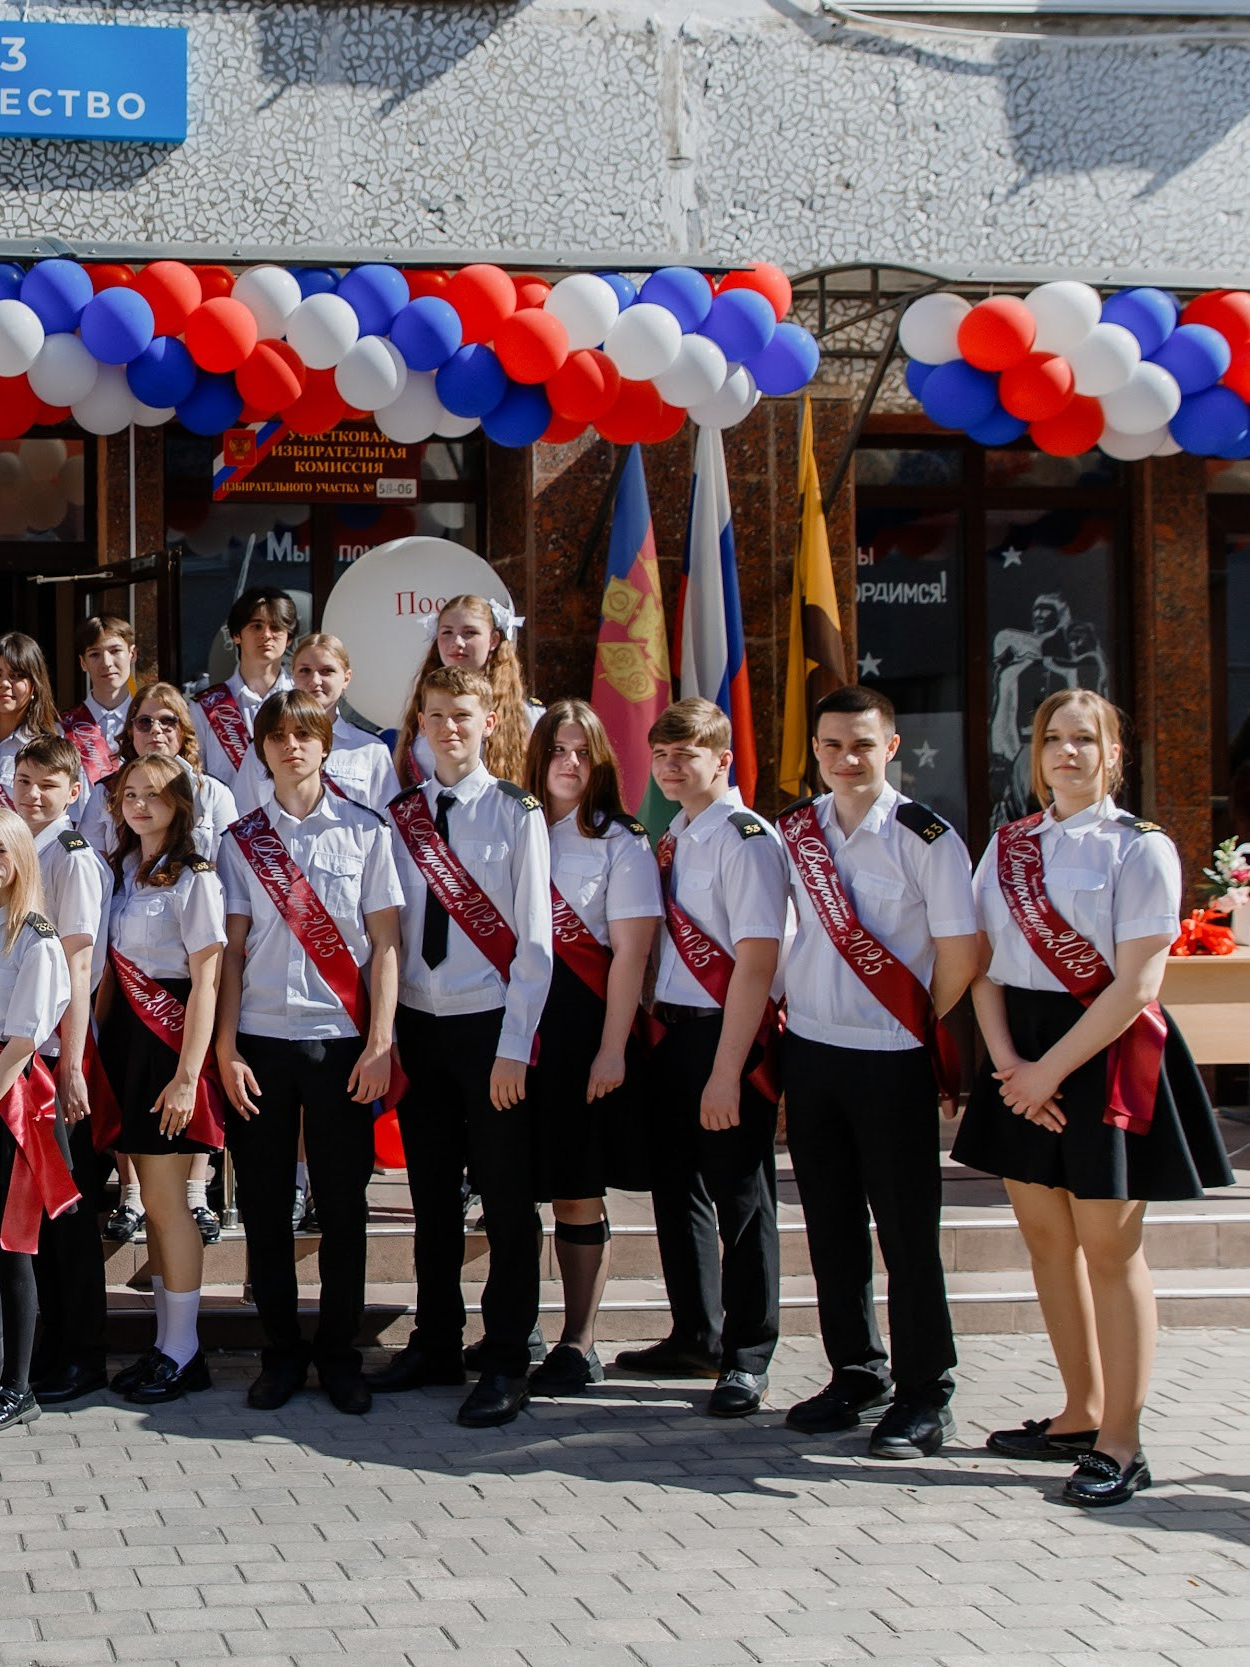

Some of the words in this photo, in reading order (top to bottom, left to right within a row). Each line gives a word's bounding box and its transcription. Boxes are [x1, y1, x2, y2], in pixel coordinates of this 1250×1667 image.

[271, 445, 407, 459] ИЗБИРАТЕЛЬНАЯ
[294, 461, 384, 474] КОМИССИЯ
[222, 481, 312, 493] ИЗБИРАТЕЛЬНОГО
[315, 482, 359, 493] УЧАСТКА
[522, 796, 539, 809] 33
[744, 824, 761, 834] 33
[923, 823, 943, 839] 33
[408, 821, 465, 898] Выпускник
[454, 891, 505, 939] 2025
[248, 836, 311, 918] Выпускник
[298, 910, 344, 960] 2025
[795, 840, 849, 932] Выпускник
[840, 928, 894, 976] 2025
[1042, 931, 1107, 978] 2025
